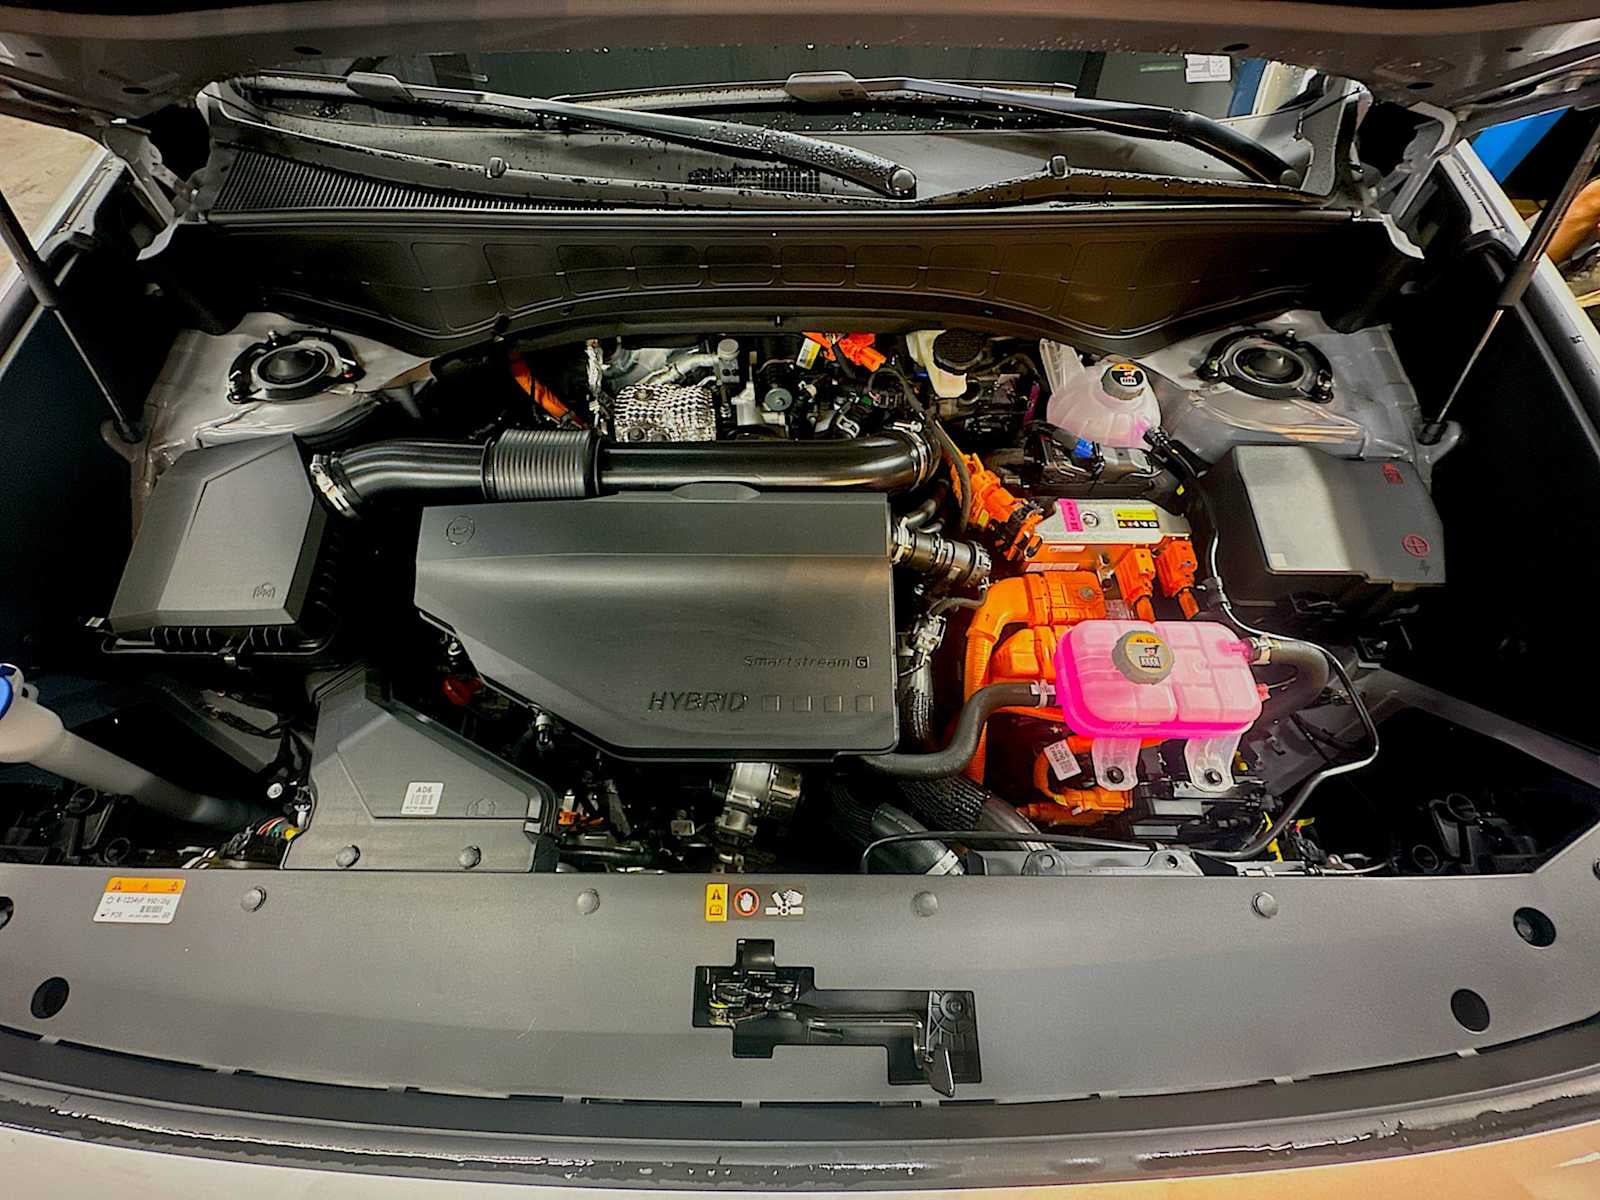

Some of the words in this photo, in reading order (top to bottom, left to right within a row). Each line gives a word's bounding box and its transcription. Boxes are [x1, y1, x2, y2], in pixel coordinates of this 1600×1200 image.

[744, 656, 850, 667] Smartstream
[856, 656, 869, 669] G
[647, 691, 749, 712] HYBRID
